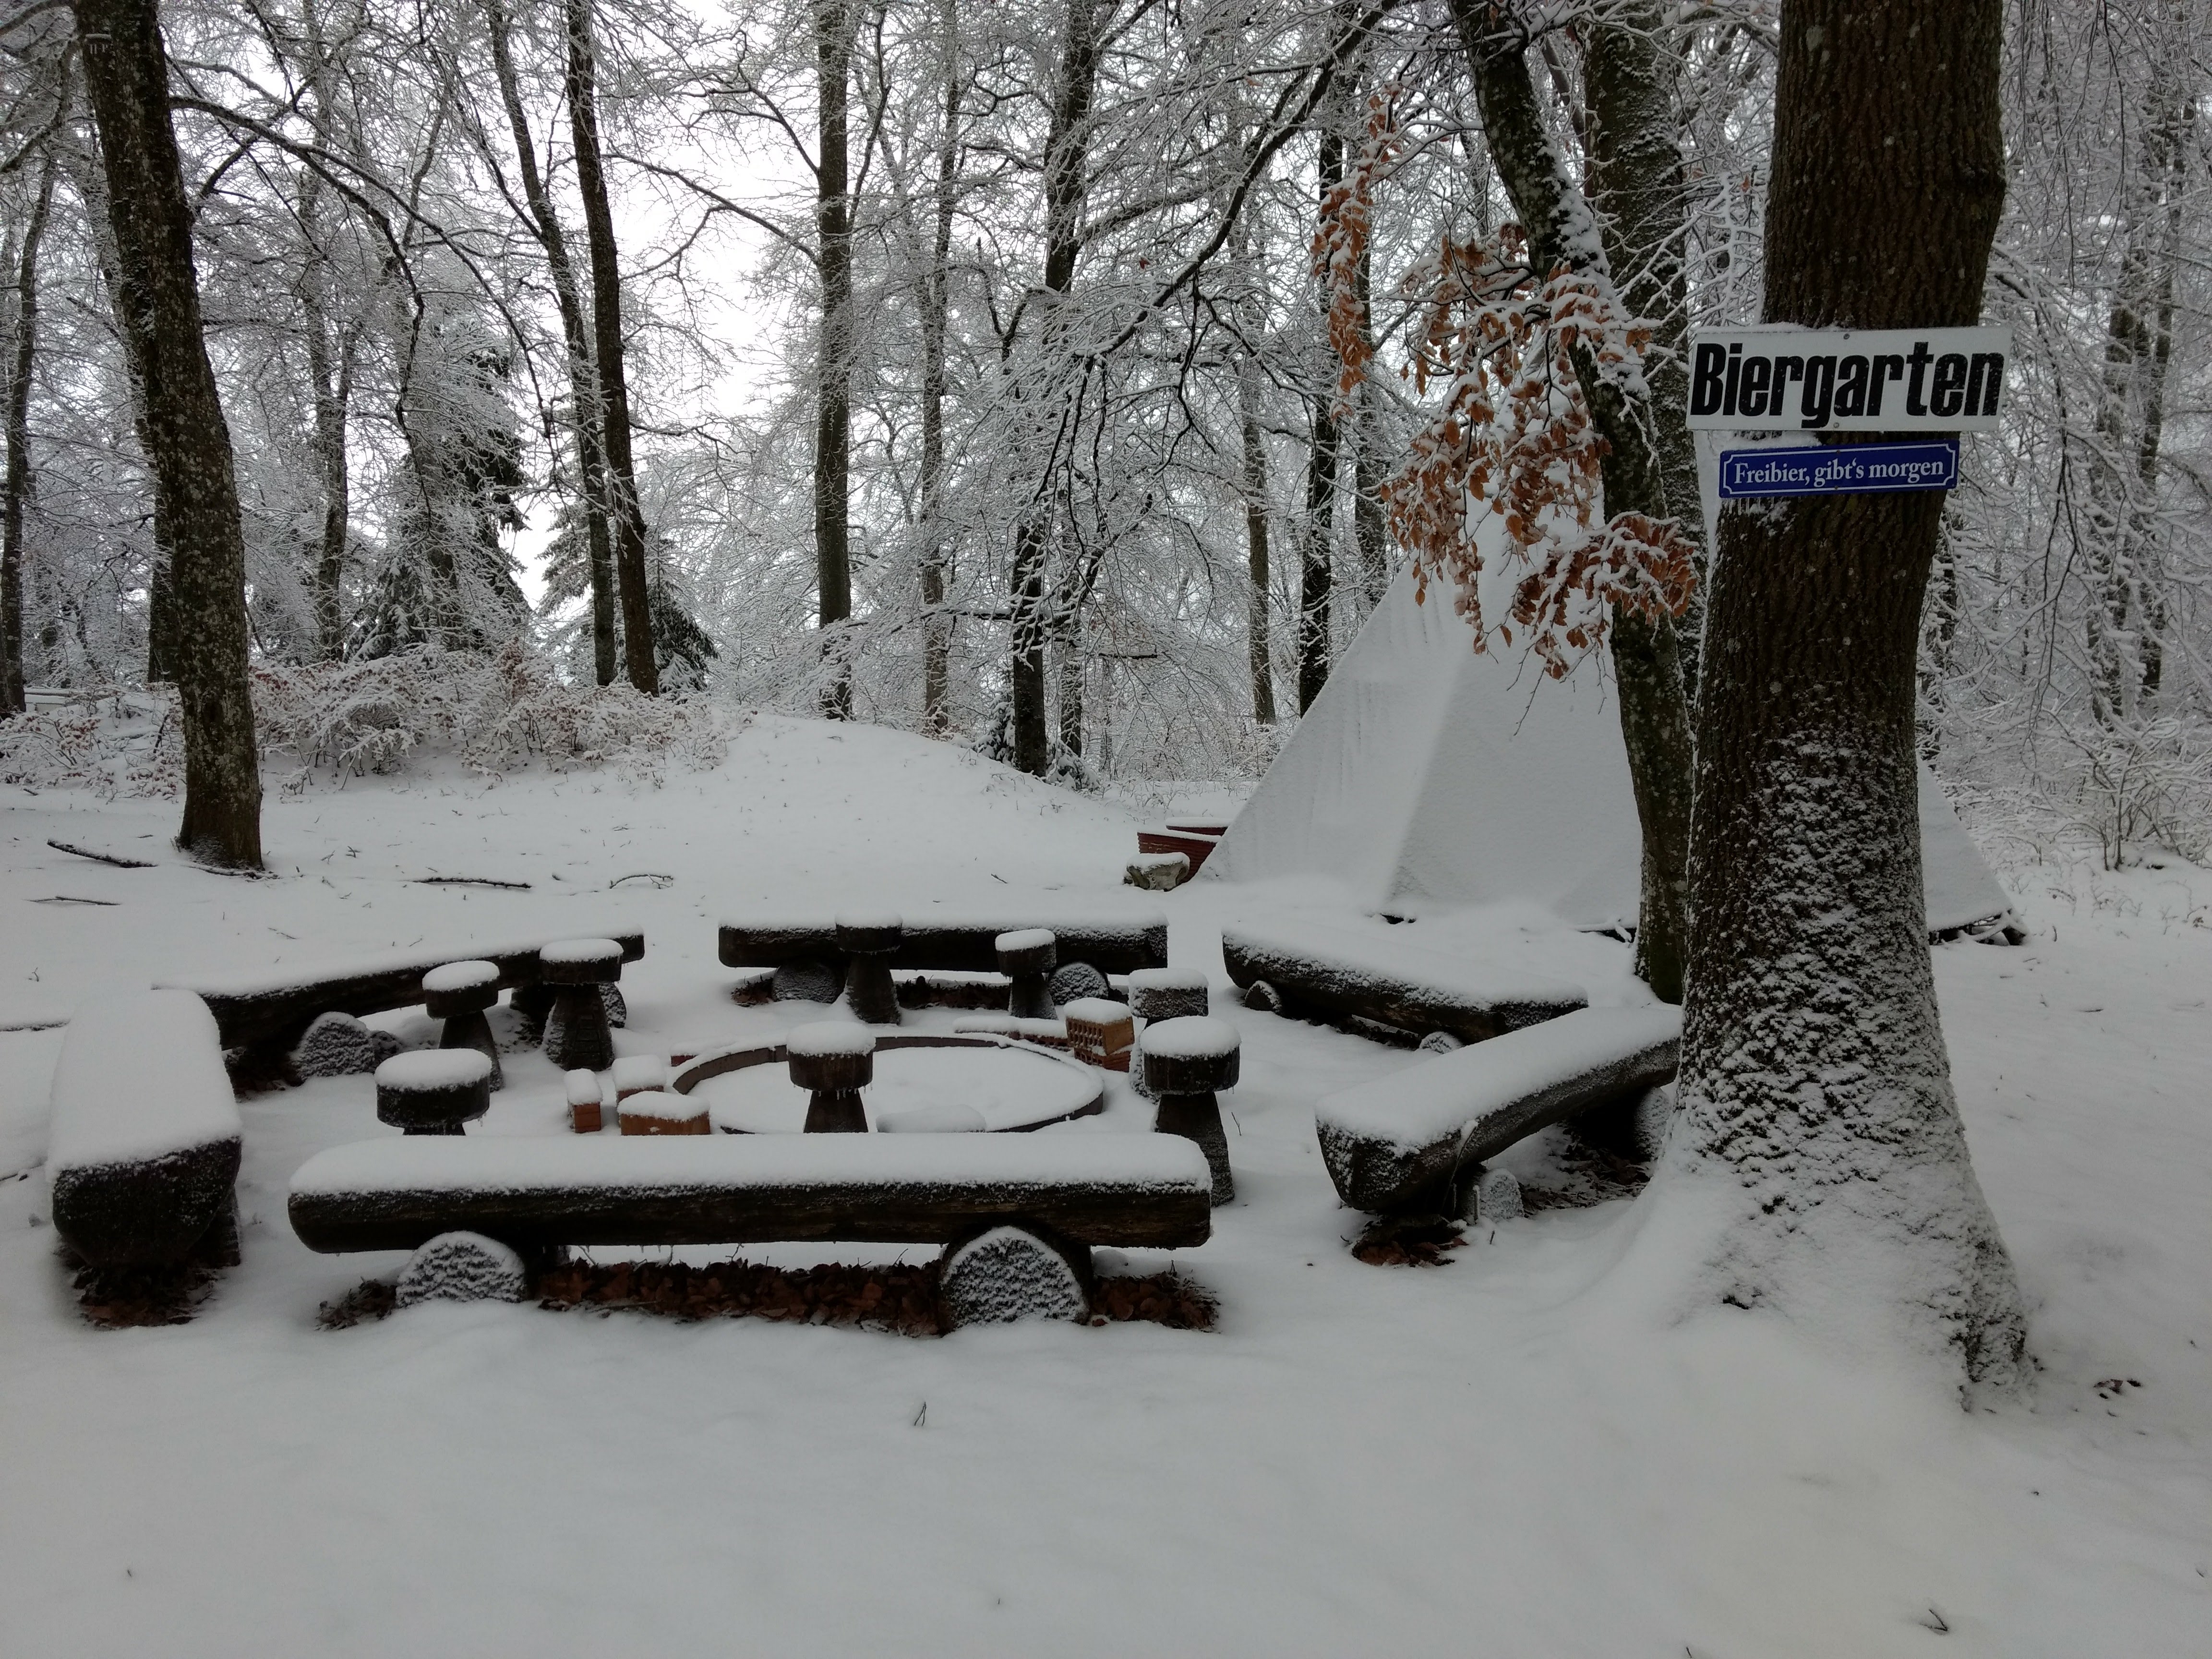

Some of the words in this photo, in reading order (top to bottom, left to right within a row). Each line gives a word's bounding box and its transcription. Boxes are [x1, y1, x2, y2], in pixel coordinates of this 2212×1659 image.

[1690, 341, 2005, 428] Biergarten
[1734, 461, 1810, 485] Freibier,
[1868, 460, 1944, 483] morgen
